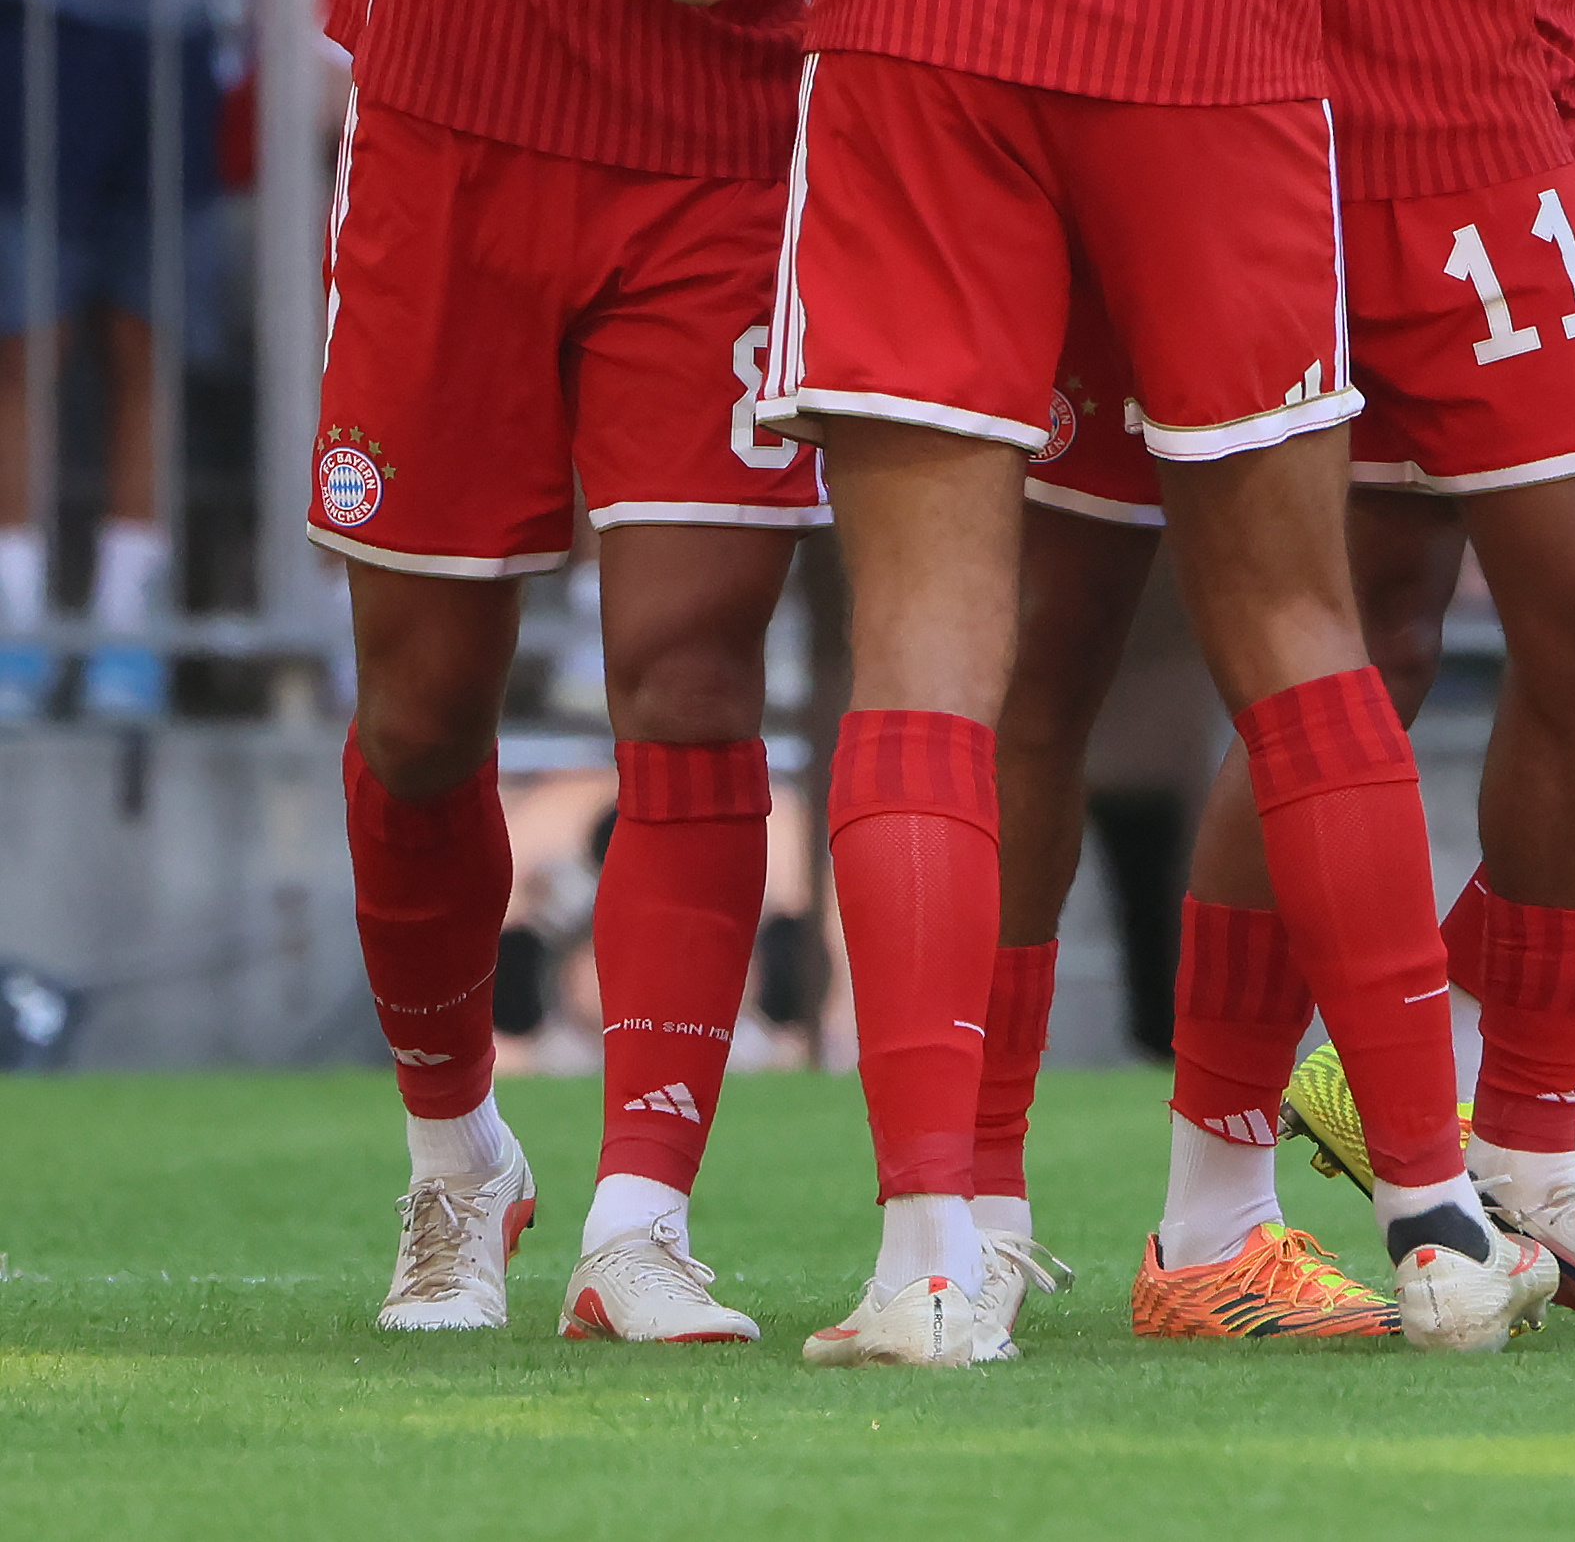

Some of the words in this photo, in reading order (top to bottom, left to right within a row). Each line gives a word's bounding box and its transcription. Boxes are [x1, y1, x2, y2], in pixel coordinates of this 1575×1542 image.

[323, 457, 335, 475] FC
[336, 452, 377, 490] BAYERN
[623, 1018, 653, 1031] MIA
[662, 1021, 704, 1036] SAN
